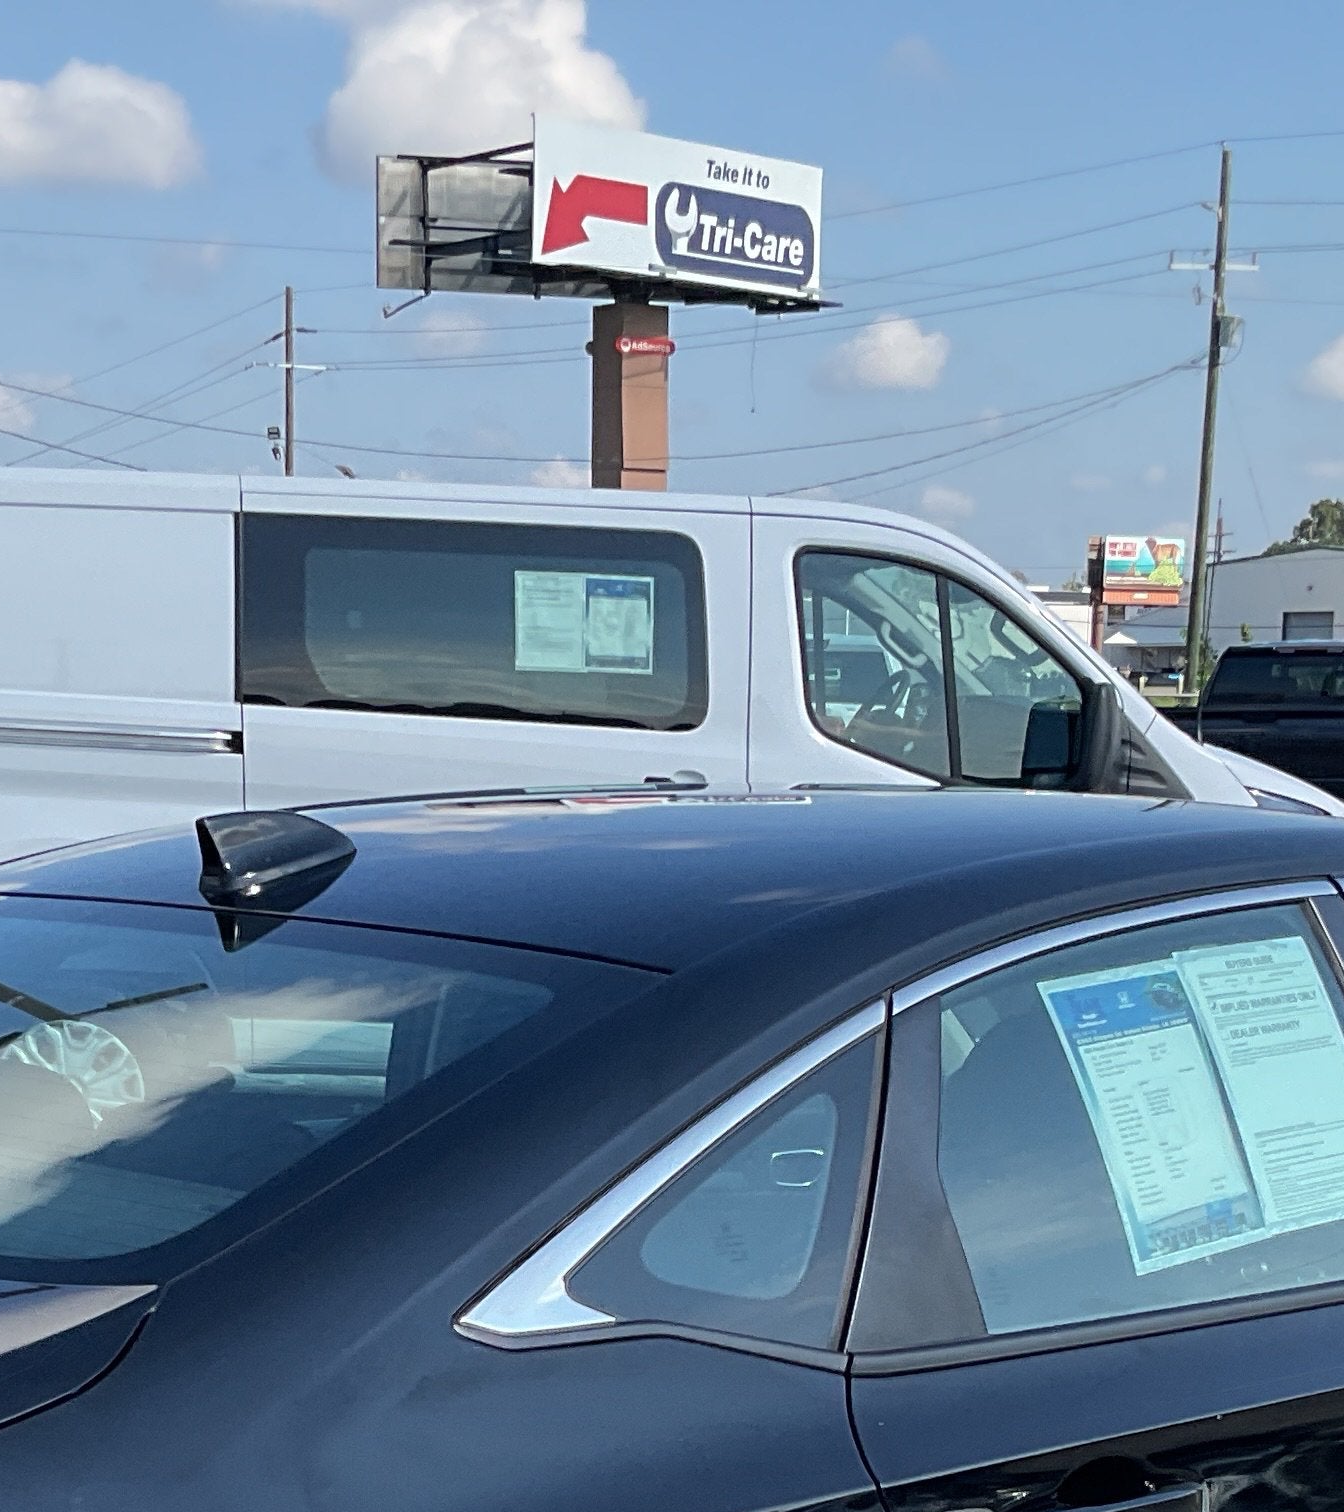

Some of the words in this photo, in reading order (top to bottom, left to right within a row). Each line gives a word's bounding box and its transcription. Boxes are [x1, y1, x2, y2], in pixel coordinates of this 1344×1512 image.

[706, 159, 739, 184] Take
[742, 166, 754, 187] It
[756, 169, 770, 190] to
[699, 214, 805, 266] Tri-Care
